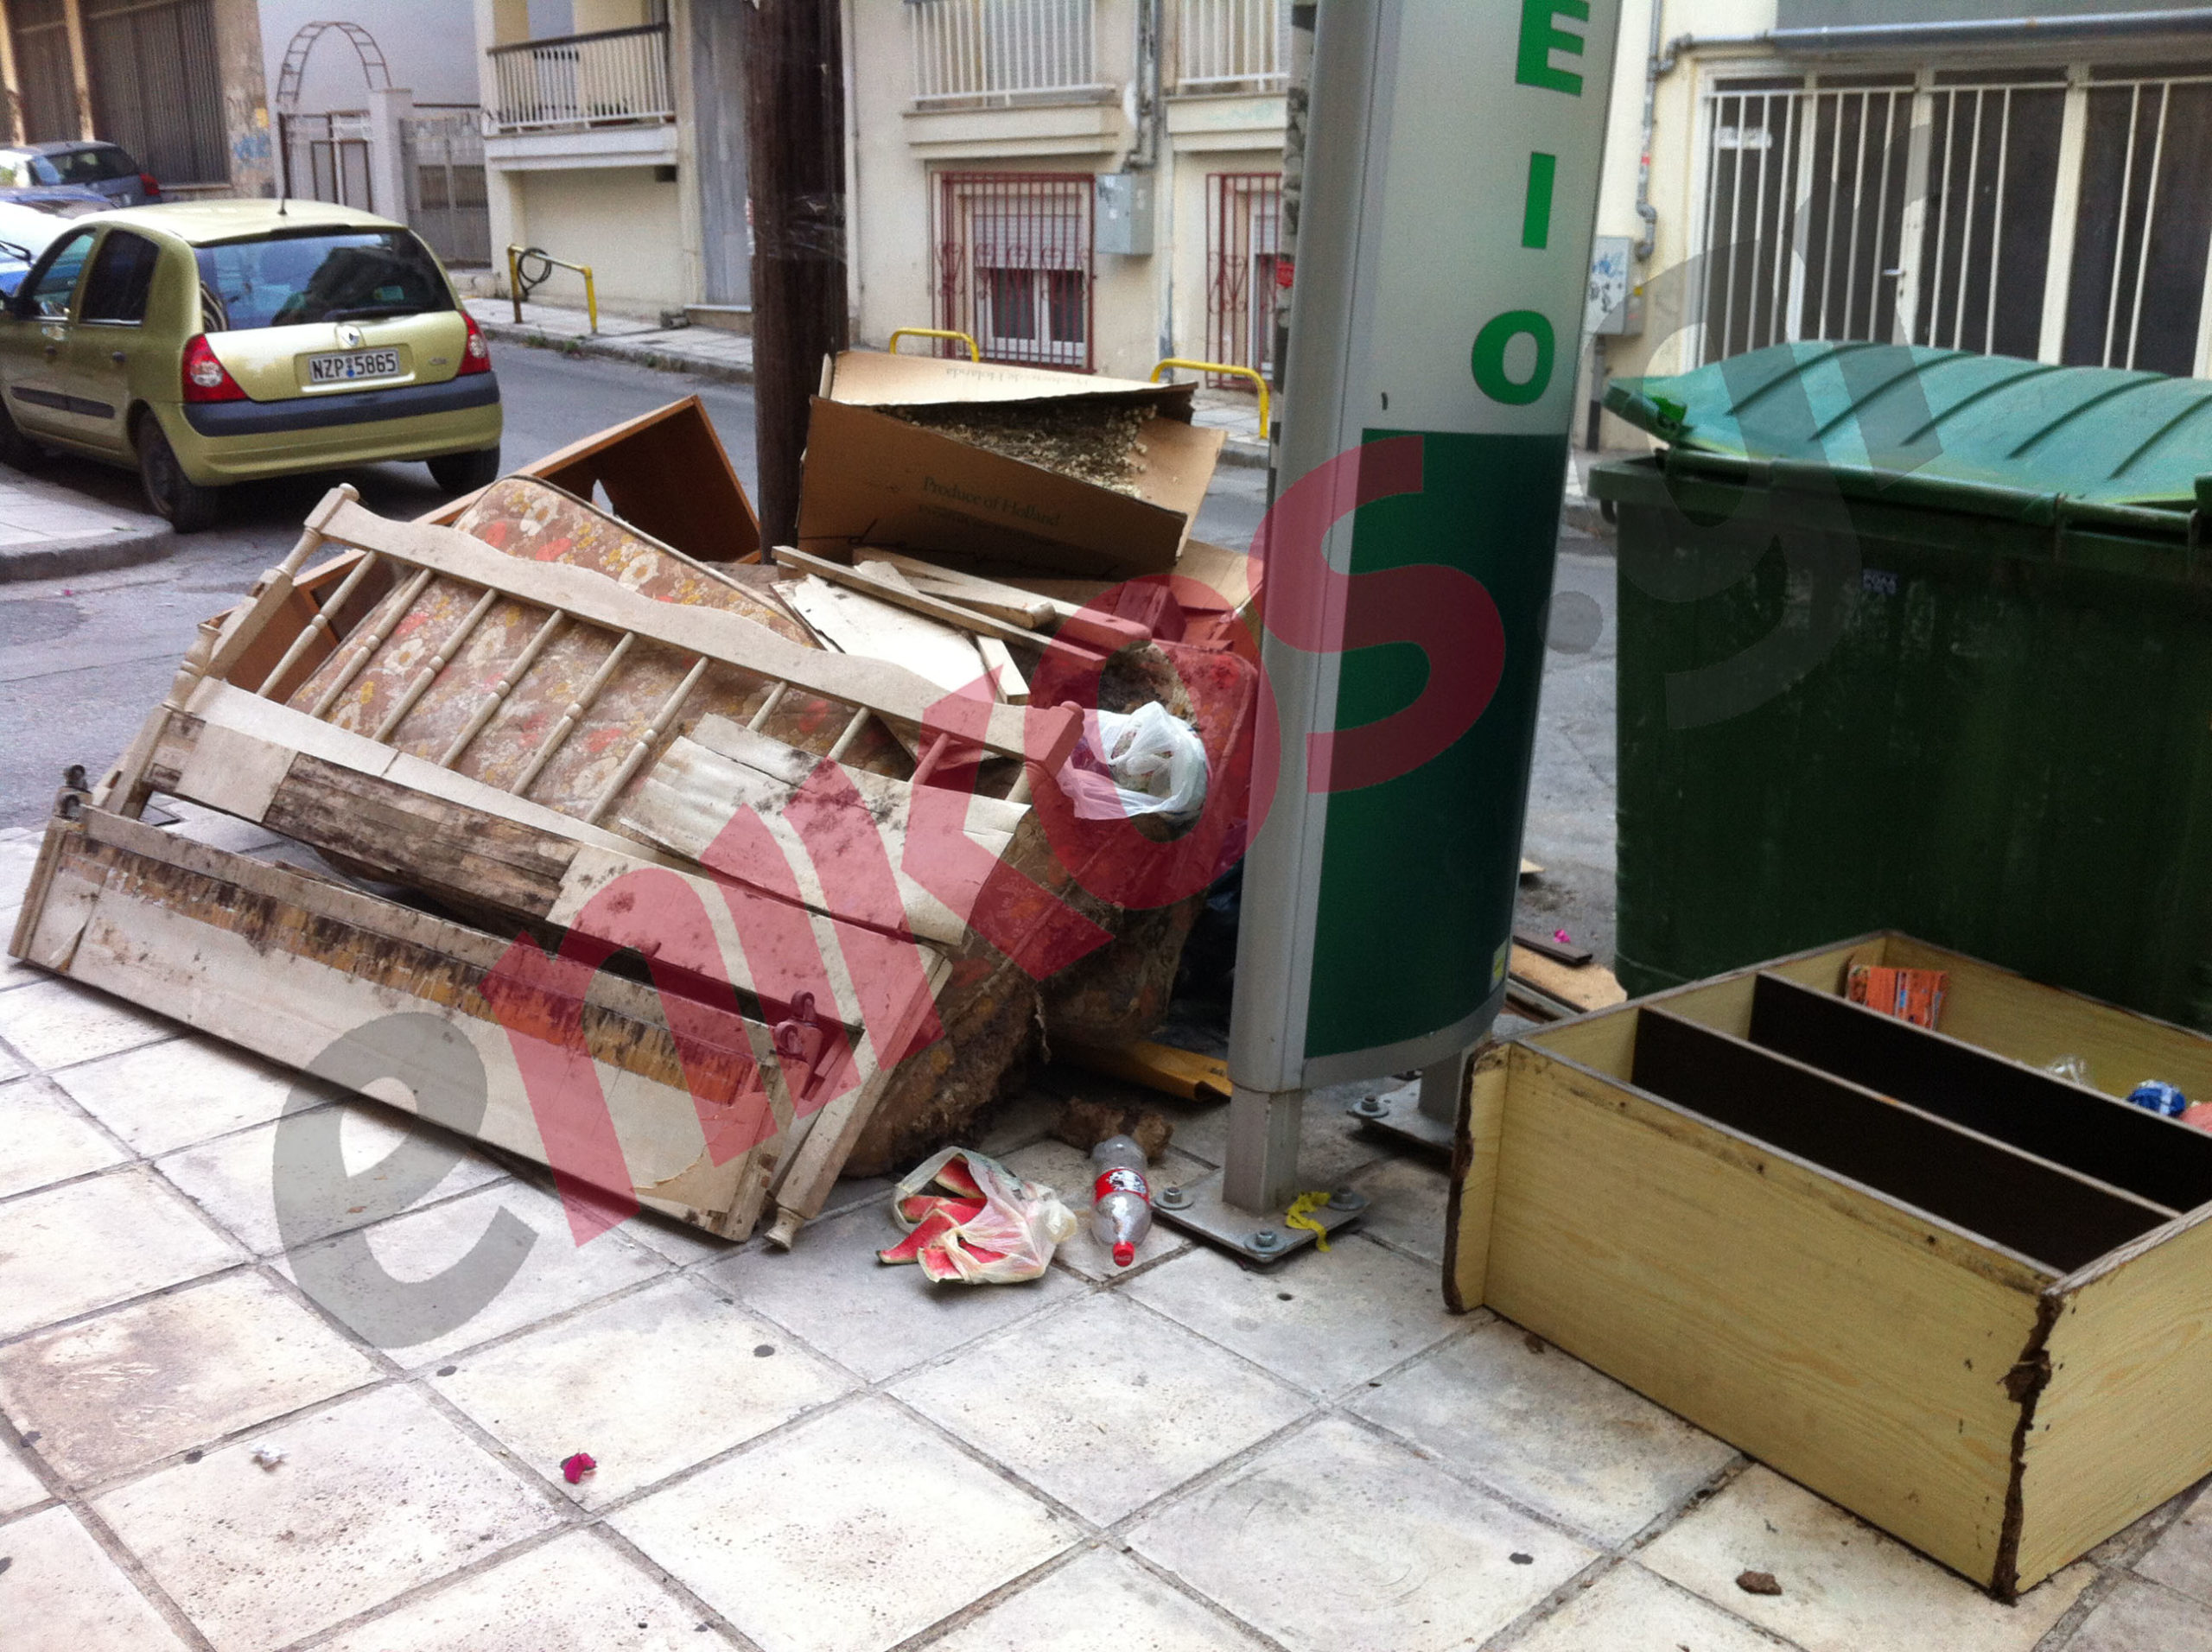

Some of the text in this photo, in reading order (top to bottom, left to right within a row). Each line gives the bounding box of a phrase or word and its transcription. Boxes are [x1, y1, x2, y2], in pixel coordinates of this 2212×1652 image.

[312, 353, 396, 379] NZP 5865
[923, 475, 982, 505] Produce
[983, 495, 1001, 510] of
[1002, 499, 1061, 526] Holland
